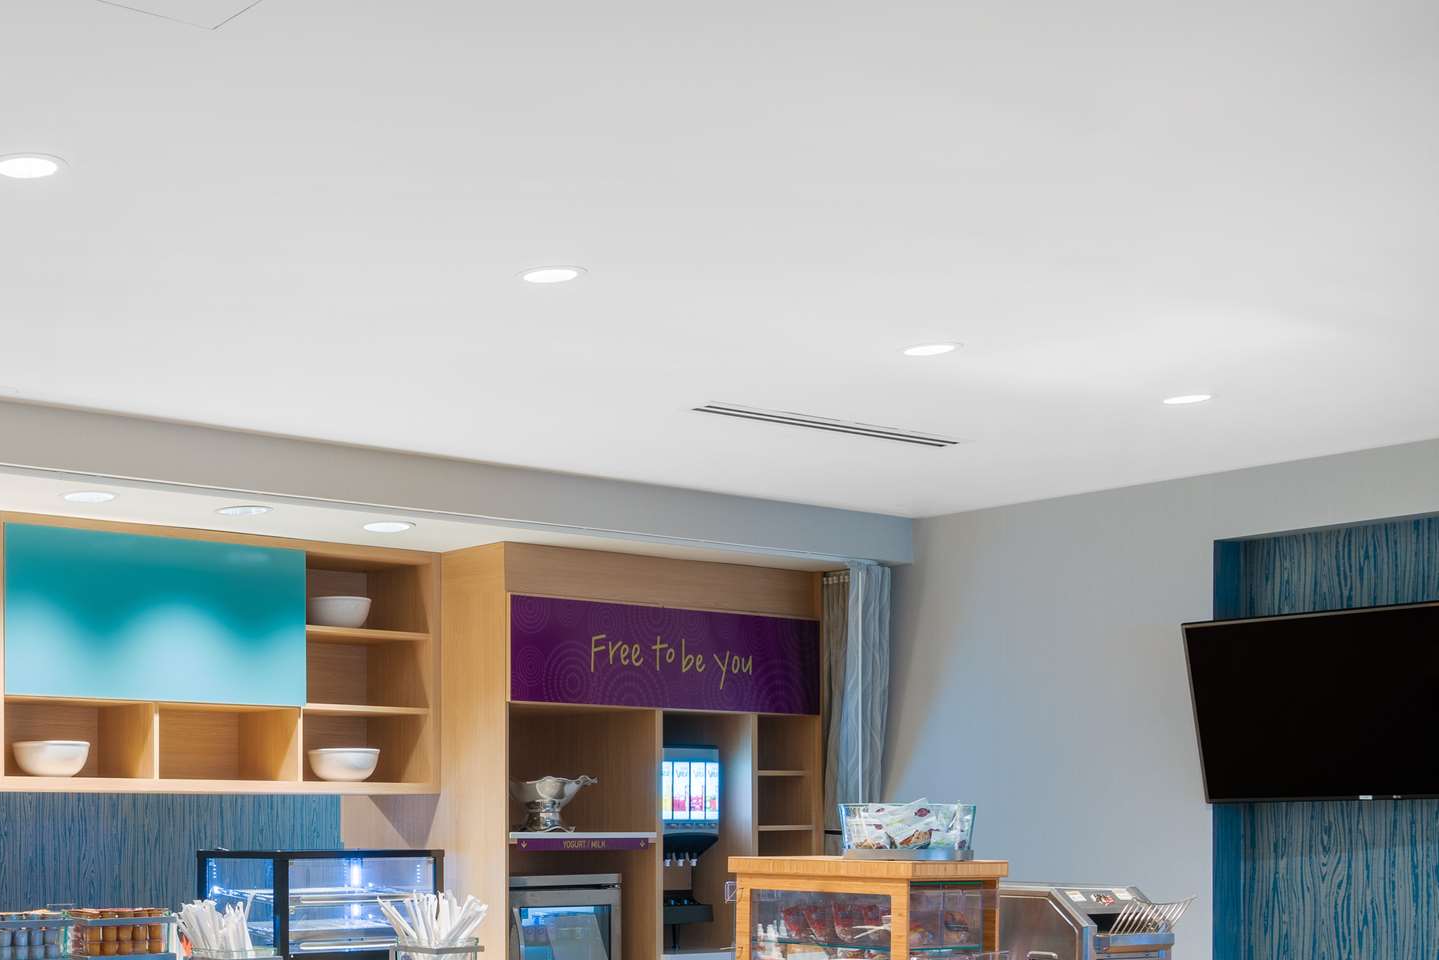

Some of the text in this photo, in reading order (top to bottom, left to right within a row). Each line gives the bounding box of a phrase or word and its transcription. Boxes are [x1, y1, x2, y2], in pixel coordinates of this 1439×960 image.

[590, 634, 753, 690] Free to be you
[562, 839, 586, 849] YOGURT
[591, 840, 606, 849] MILK
